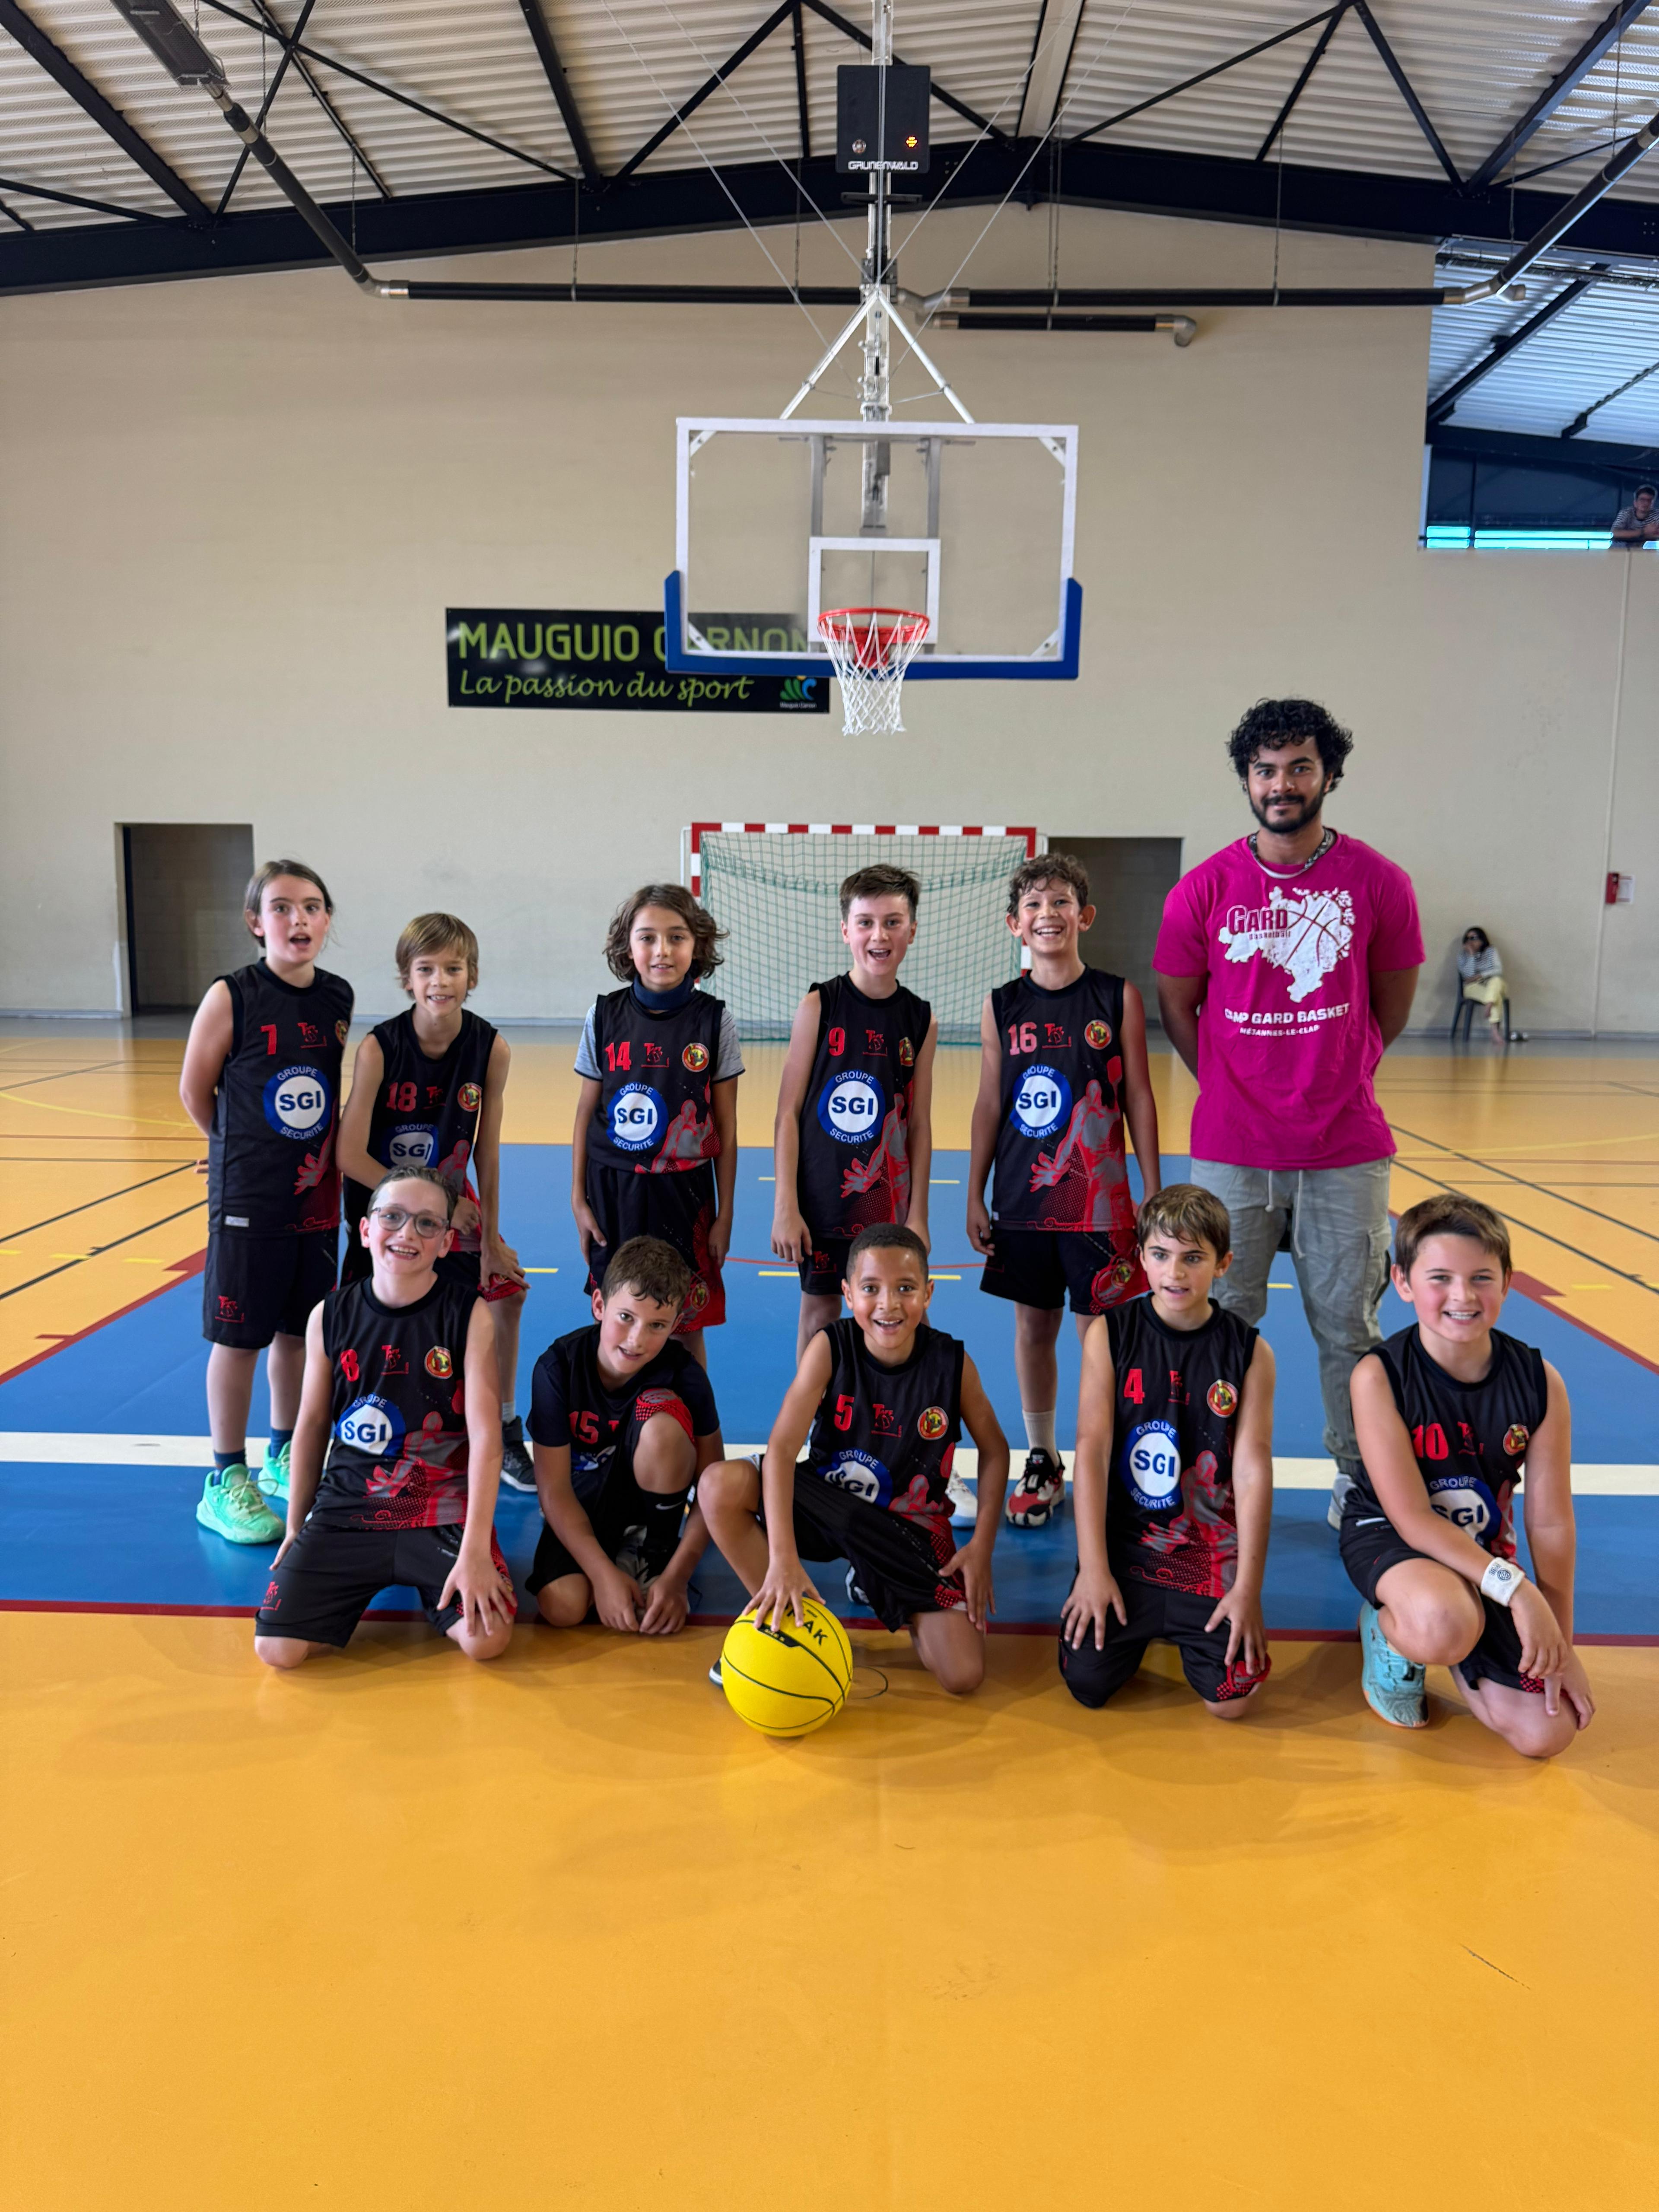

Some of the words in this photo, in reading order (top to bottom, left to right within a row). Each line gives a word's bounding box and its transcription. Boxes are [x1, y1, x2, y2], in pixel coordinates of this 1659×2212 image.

[458, 621, 639, 661] MAUGUIO
[654, 626, 809, 661] CRNON
[460, 669, 502, 694] La
[504, 673, 623, 704] passion
[626, 671, 674, 698] du
[677, 675, 755, 707] sport
[1226, 905, 1288, 935] GARD
[1251, 1012, 1294, 1024] GARD
[1297, 1002, 1350, 1023] BASKET
[828, 1027, 845, 1056] 9
[1008, 1021, 1037, 1056] 16
[605, 1042, 632, 1071] 14
[276, 1065, 318, 1081] GROUPE
[835, 1071, 874, 1084] GROUPE
[279, 1091, 321, 1111] SGI
[386, 1081, 417, 1112] 18
[832, 1096, 874, 1115] SGI
[1018, 1090, 1056, 1109] SGI
[617, 1107, 653, 1125] SGI
[280, 1122, 324, 1140] SECURITE
[830, 1128, 874, 1144] SECURITE
[392, 1143, 431, 1160] SGI
[613, 1136, 654, 1152] SECURITE
[1124, 1368, 1145, 1404] 4
[834, 1394, 855, 1431] 5
[344, 1421, 387, 1443] SGI
[569, 1411, 599, 1444] 15
[1411, 1423, 1449, 1461] 10
[839, 1449, 879, 1470] GROUPE
[1134, 1450, 1176, 1478] SGI
[1130, 1487, 1177, 1510] SECURITE
